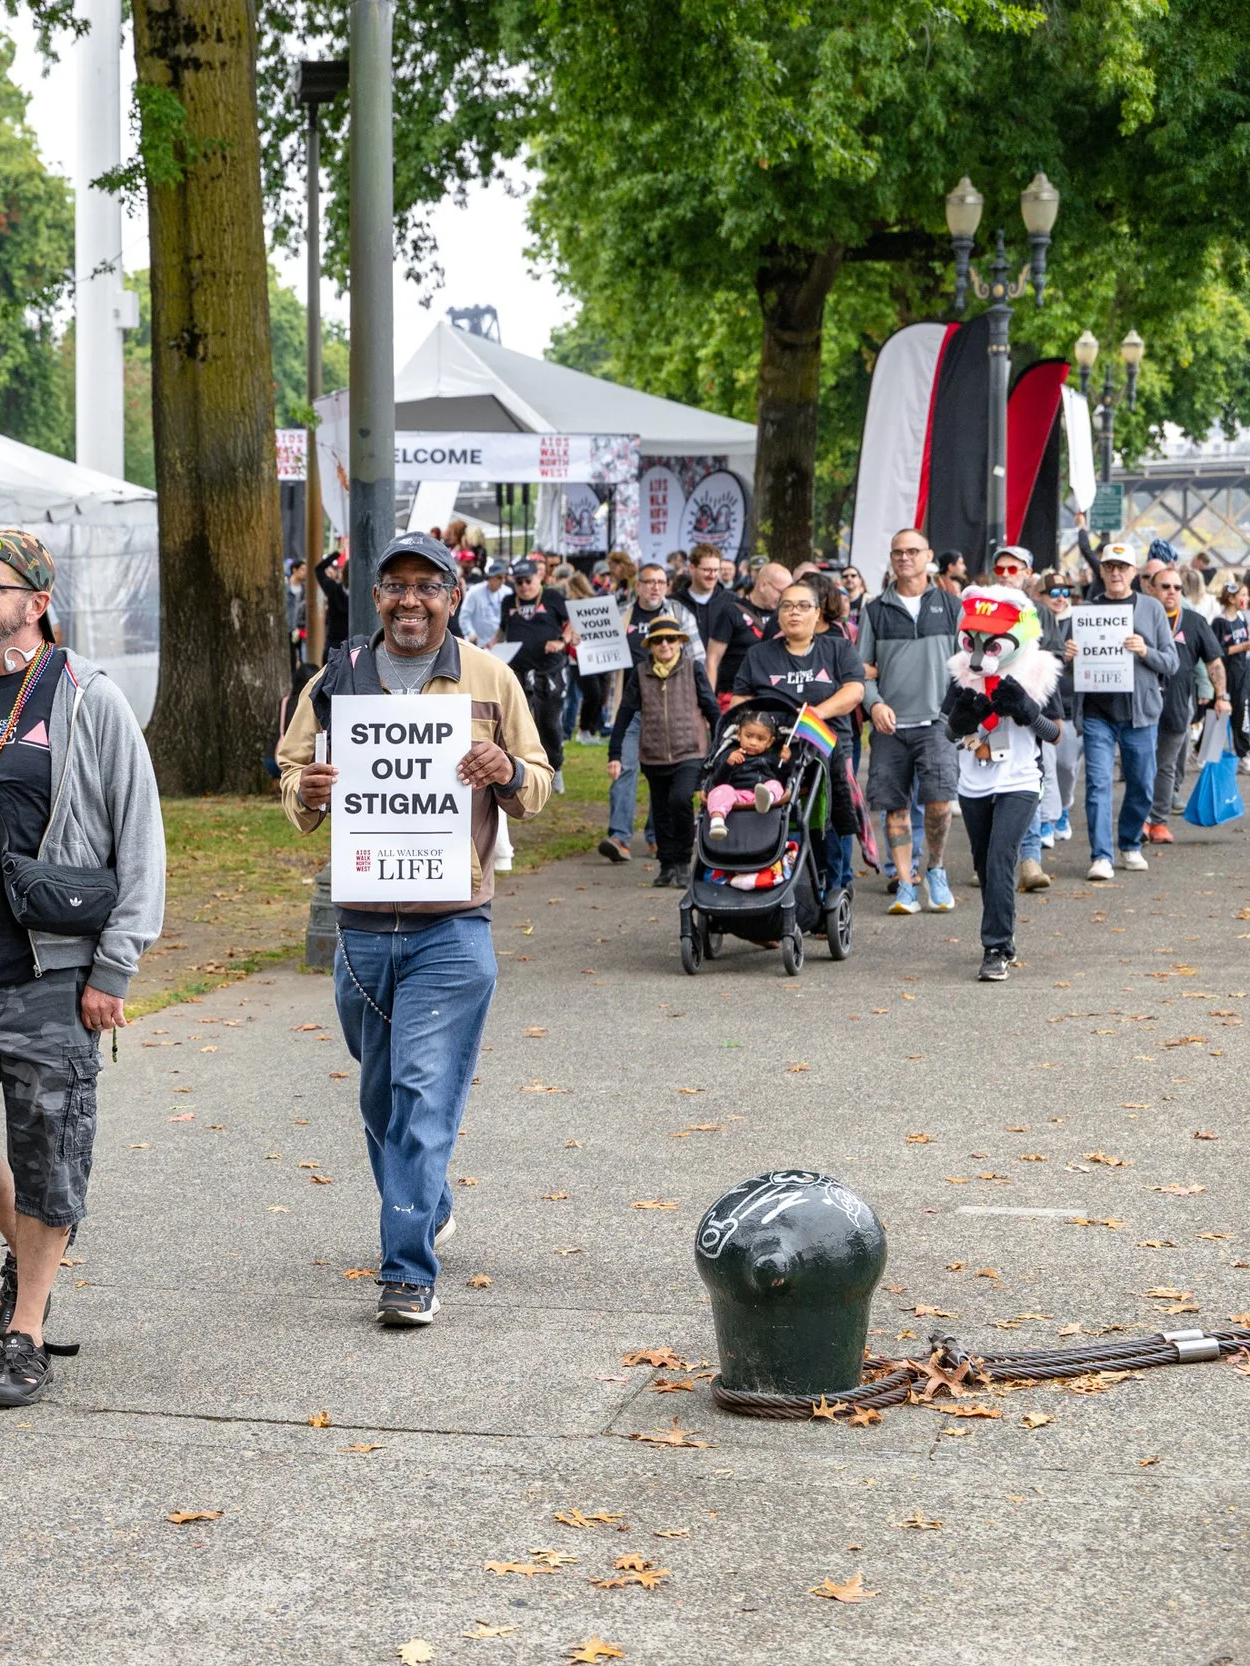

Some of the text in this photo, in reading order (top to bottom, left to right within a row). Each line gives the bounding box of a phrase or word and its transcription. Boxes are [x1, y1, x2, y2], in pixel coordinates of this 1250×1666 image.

[395, 449, 482, 464] LCOME
[576, 606, 610, 618] KNOW
[582, 618, 612, 629] YOUR
[1077, 617, 1129, 627] SILENCE
[580, 629, 620, 641] STATUS
[1083, 646, 1124, 656] DEATH
[1093, 673, 1122, 684] LIFE
[350, 723, 454, 745] STOMP
[371, 758, 432, 780] OUT
[344, 793, 459, 815] STIGMA
[377, 849, 444, 857] ALL WALKS OF
[377, 859, 444, 880] LIFE
